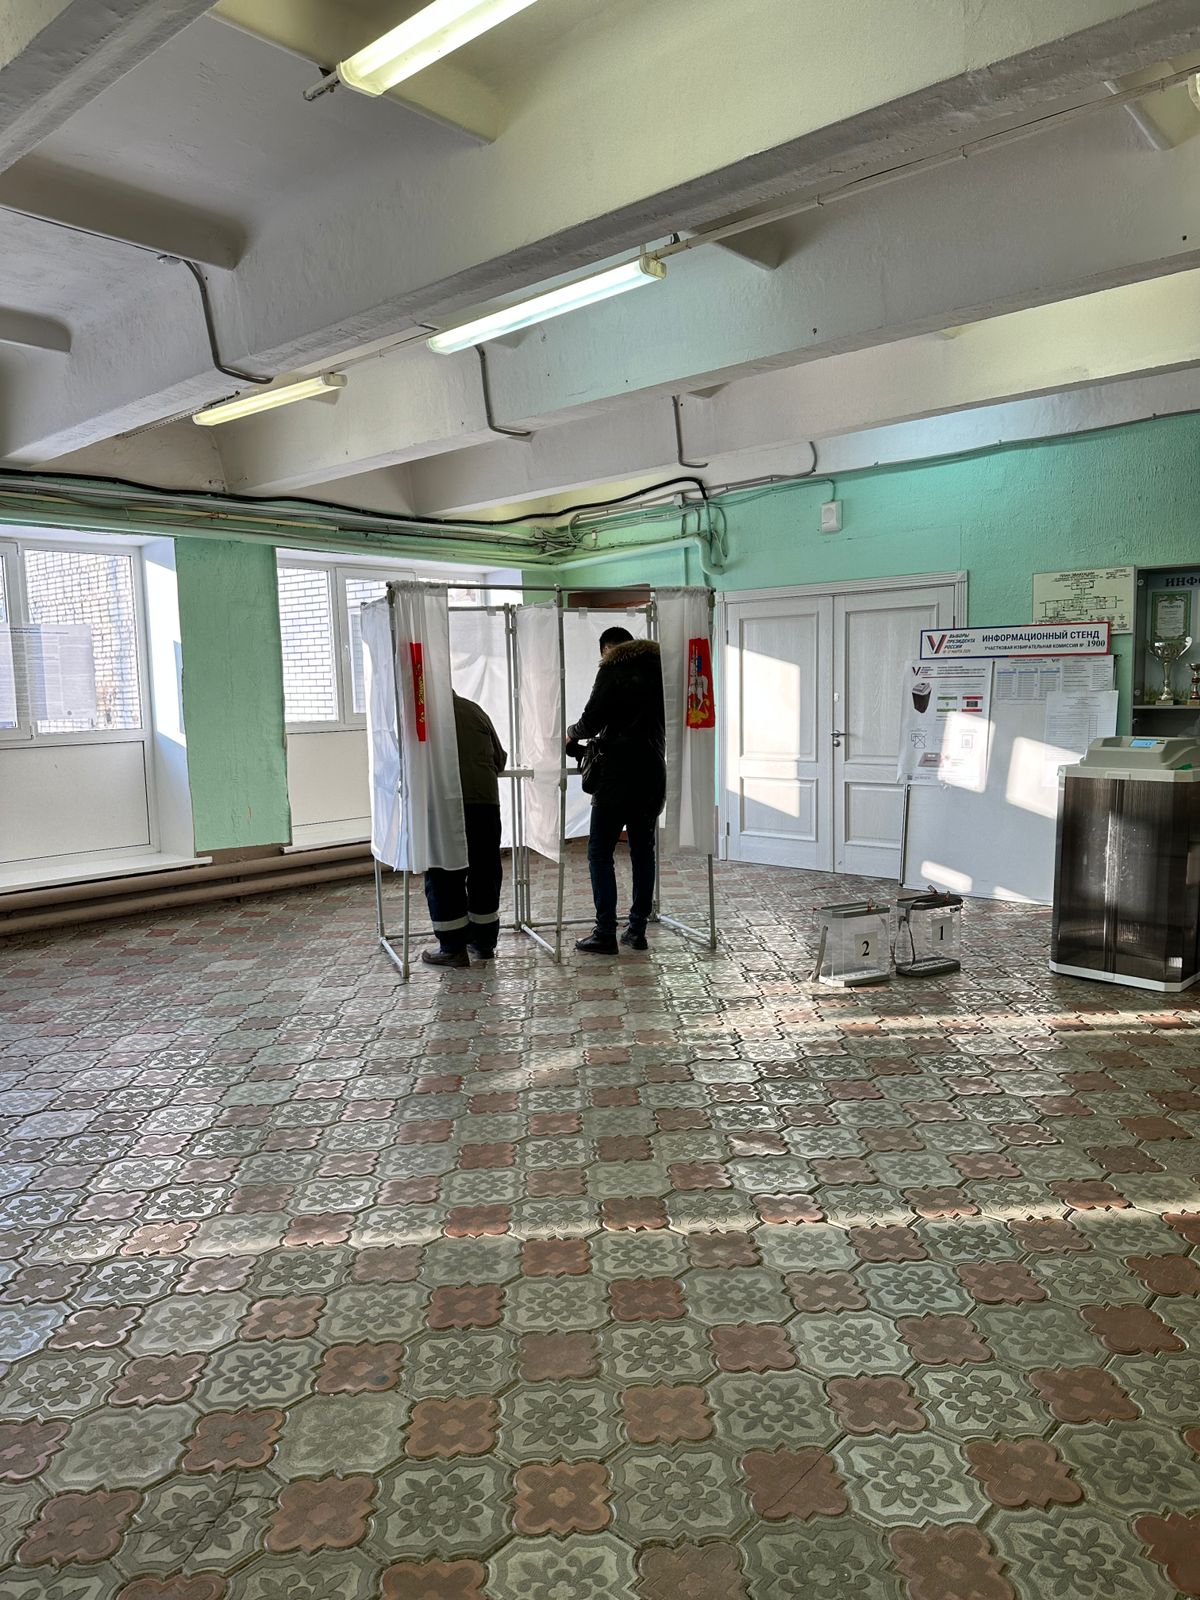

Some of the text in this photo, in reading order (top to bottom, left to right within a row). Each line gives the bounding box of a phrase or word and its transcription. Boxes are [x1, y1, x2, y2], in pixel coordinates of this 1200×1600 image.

[1165, 576, 1200, 587] ИНФ
[982, 630, 1100, 642] ИНФОРМАЦИОННЫЙ СТЕНД
[940, 925, 945, 940] 1
[862, 940, 870, 956] 2
